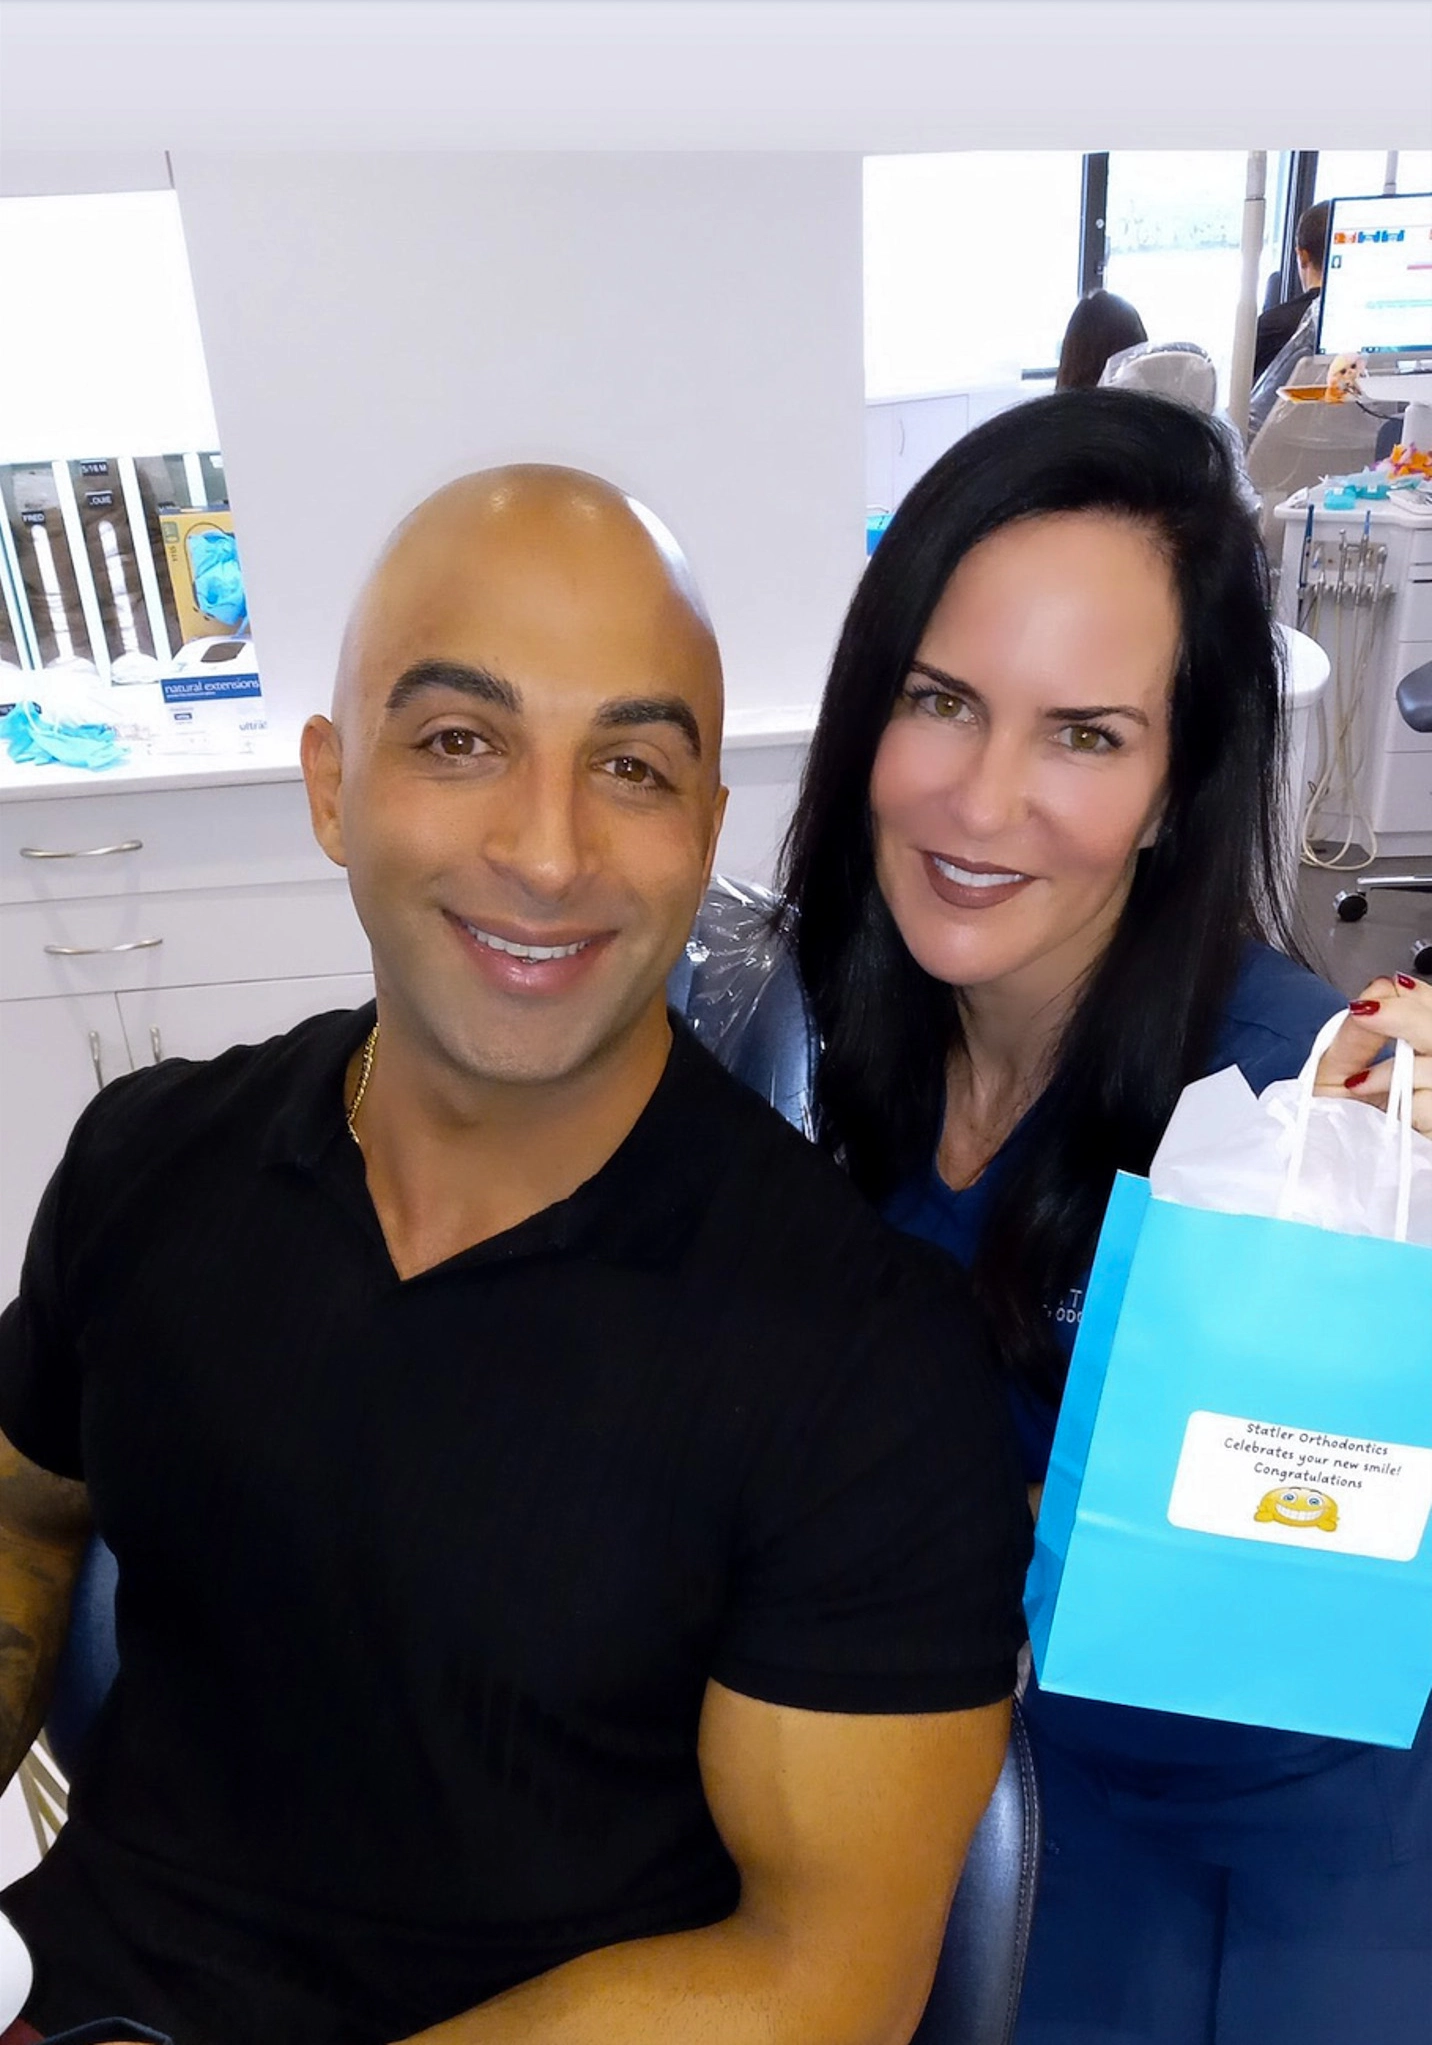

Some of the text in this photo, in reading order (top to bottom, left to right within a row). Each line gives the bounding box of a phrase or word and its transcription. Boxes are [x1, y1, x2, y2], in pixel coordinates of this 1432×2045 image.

[164, 677, 260, 693] natural extensions
[1246, 1423, 1388, 1455] Statler Orthodontics
[1223, 1437, 1402, 1476] Celebrates your new smile!
[1253, 1461, 1362, 1489] Congratulations
